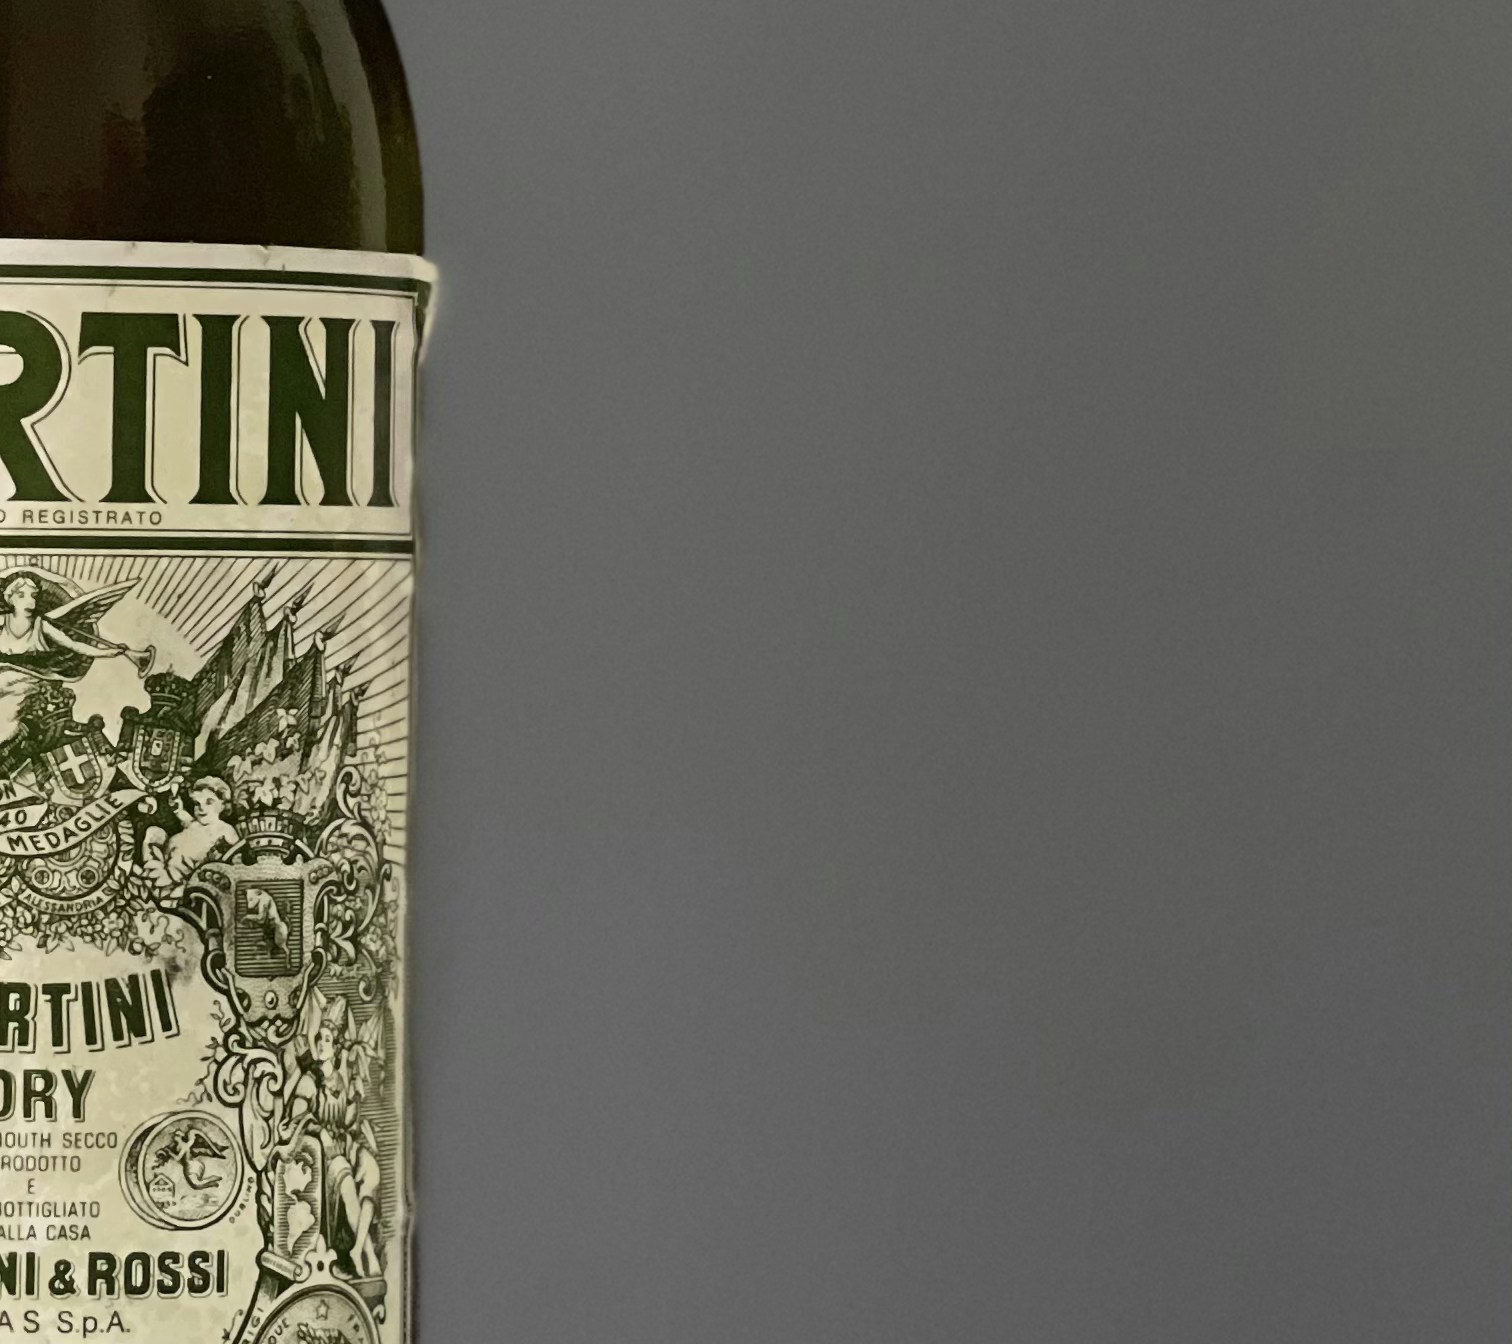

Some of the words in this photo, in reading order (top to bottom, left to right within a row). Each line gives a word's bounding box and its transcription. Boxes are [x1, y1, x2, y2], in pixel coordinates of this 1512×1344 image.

[22, 509, 163, 526] REGISTRATO
[6, 794, 124, 852] MEDAGLIE
[62, 1131, 119, 1149] SECCO
[27, 1178, 36, 1194] E
[46, 1224, 92, 1241] CASA
[48, 1258, 82, 1300] &
[87, 1248, 230, 1300] ROSSI
[56, 1309, 131, 1338] S.p.A.
